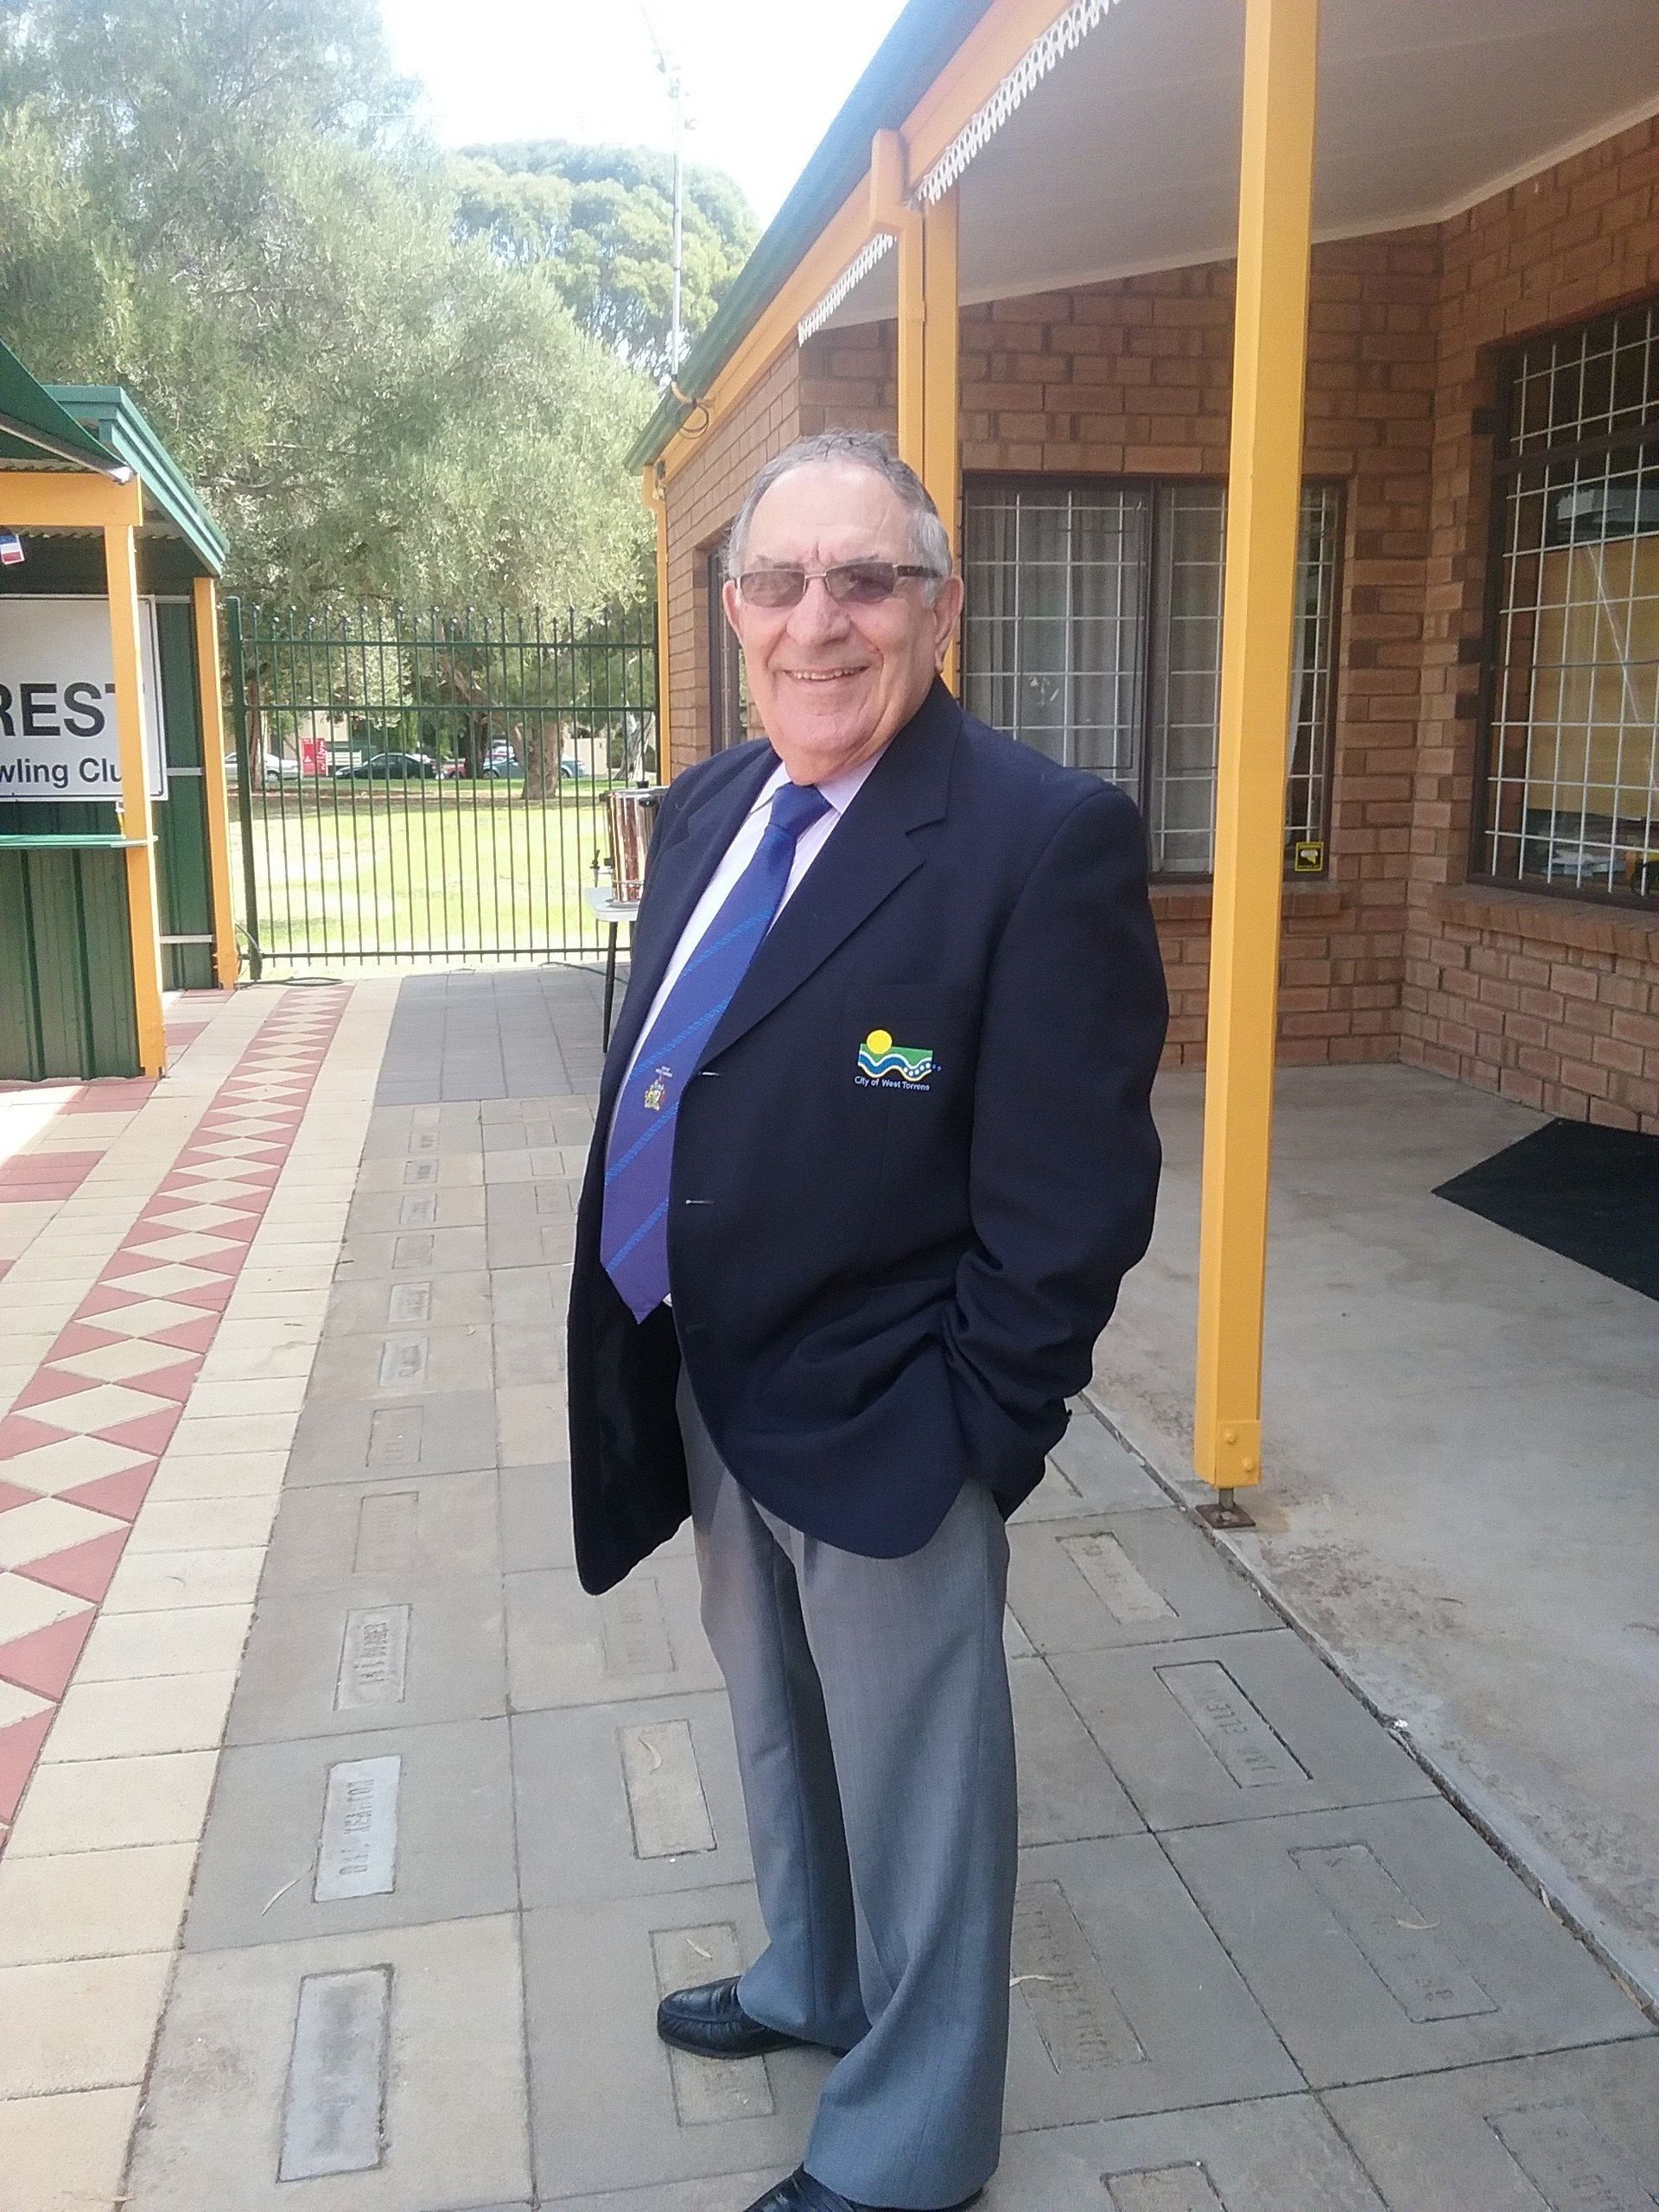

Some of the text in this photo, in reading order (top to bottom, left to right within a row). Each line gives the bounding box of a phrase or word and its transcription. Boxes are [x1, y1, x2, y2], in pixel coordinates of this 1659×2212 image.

[0, 682, 116, 737] ES
[854, 1076, 869, 1087] City
[881, 1079, 901, 1089] West
[902, 1081, 930, 1090] Torrens
